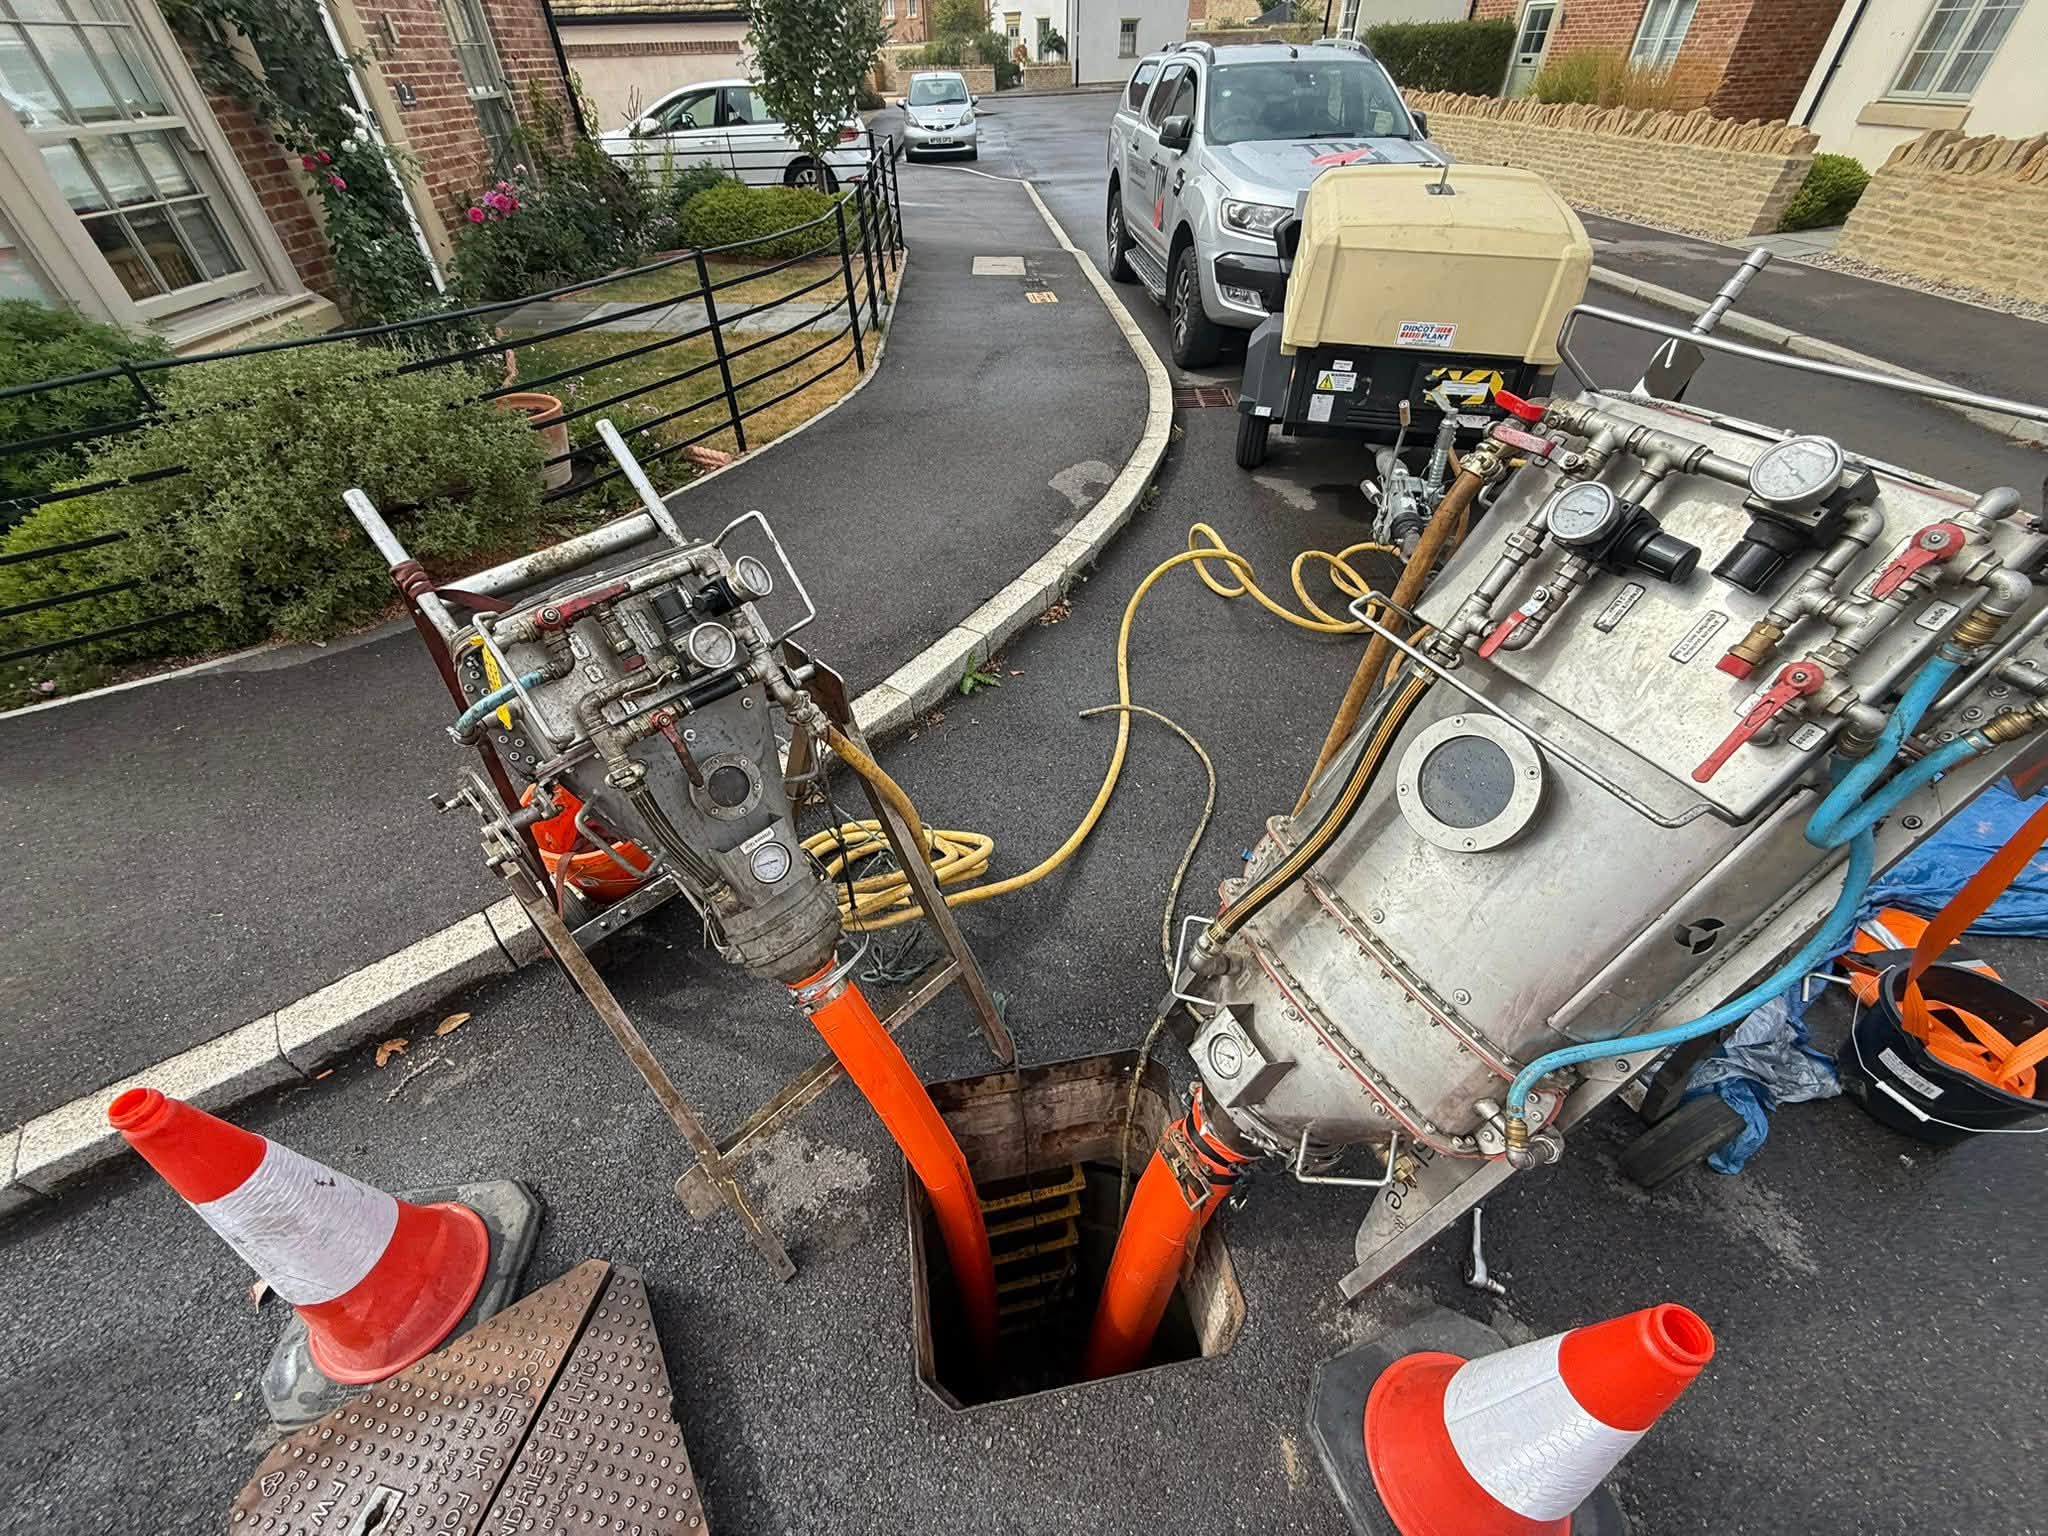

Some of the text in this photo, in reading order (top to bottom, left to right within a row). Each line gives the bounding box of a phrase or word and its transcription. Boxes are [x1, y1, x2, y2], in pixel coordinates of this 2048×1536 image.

[1402, 325, 1436, 333] DIDCOT
[1422, 332, 1449, 340] PLANT
[492, 1348, 545, 1437] ECCLES
[552, 1405, 577, 1440] FE
[567, 1359, 598, 1404] LTD
[457, 1416, 476, 1440] EN
[467, 1446, 498, 1480] UK
[312, 1480, 349, 1527] FW
[543, 1450, 589, 1530] DUCTILE
